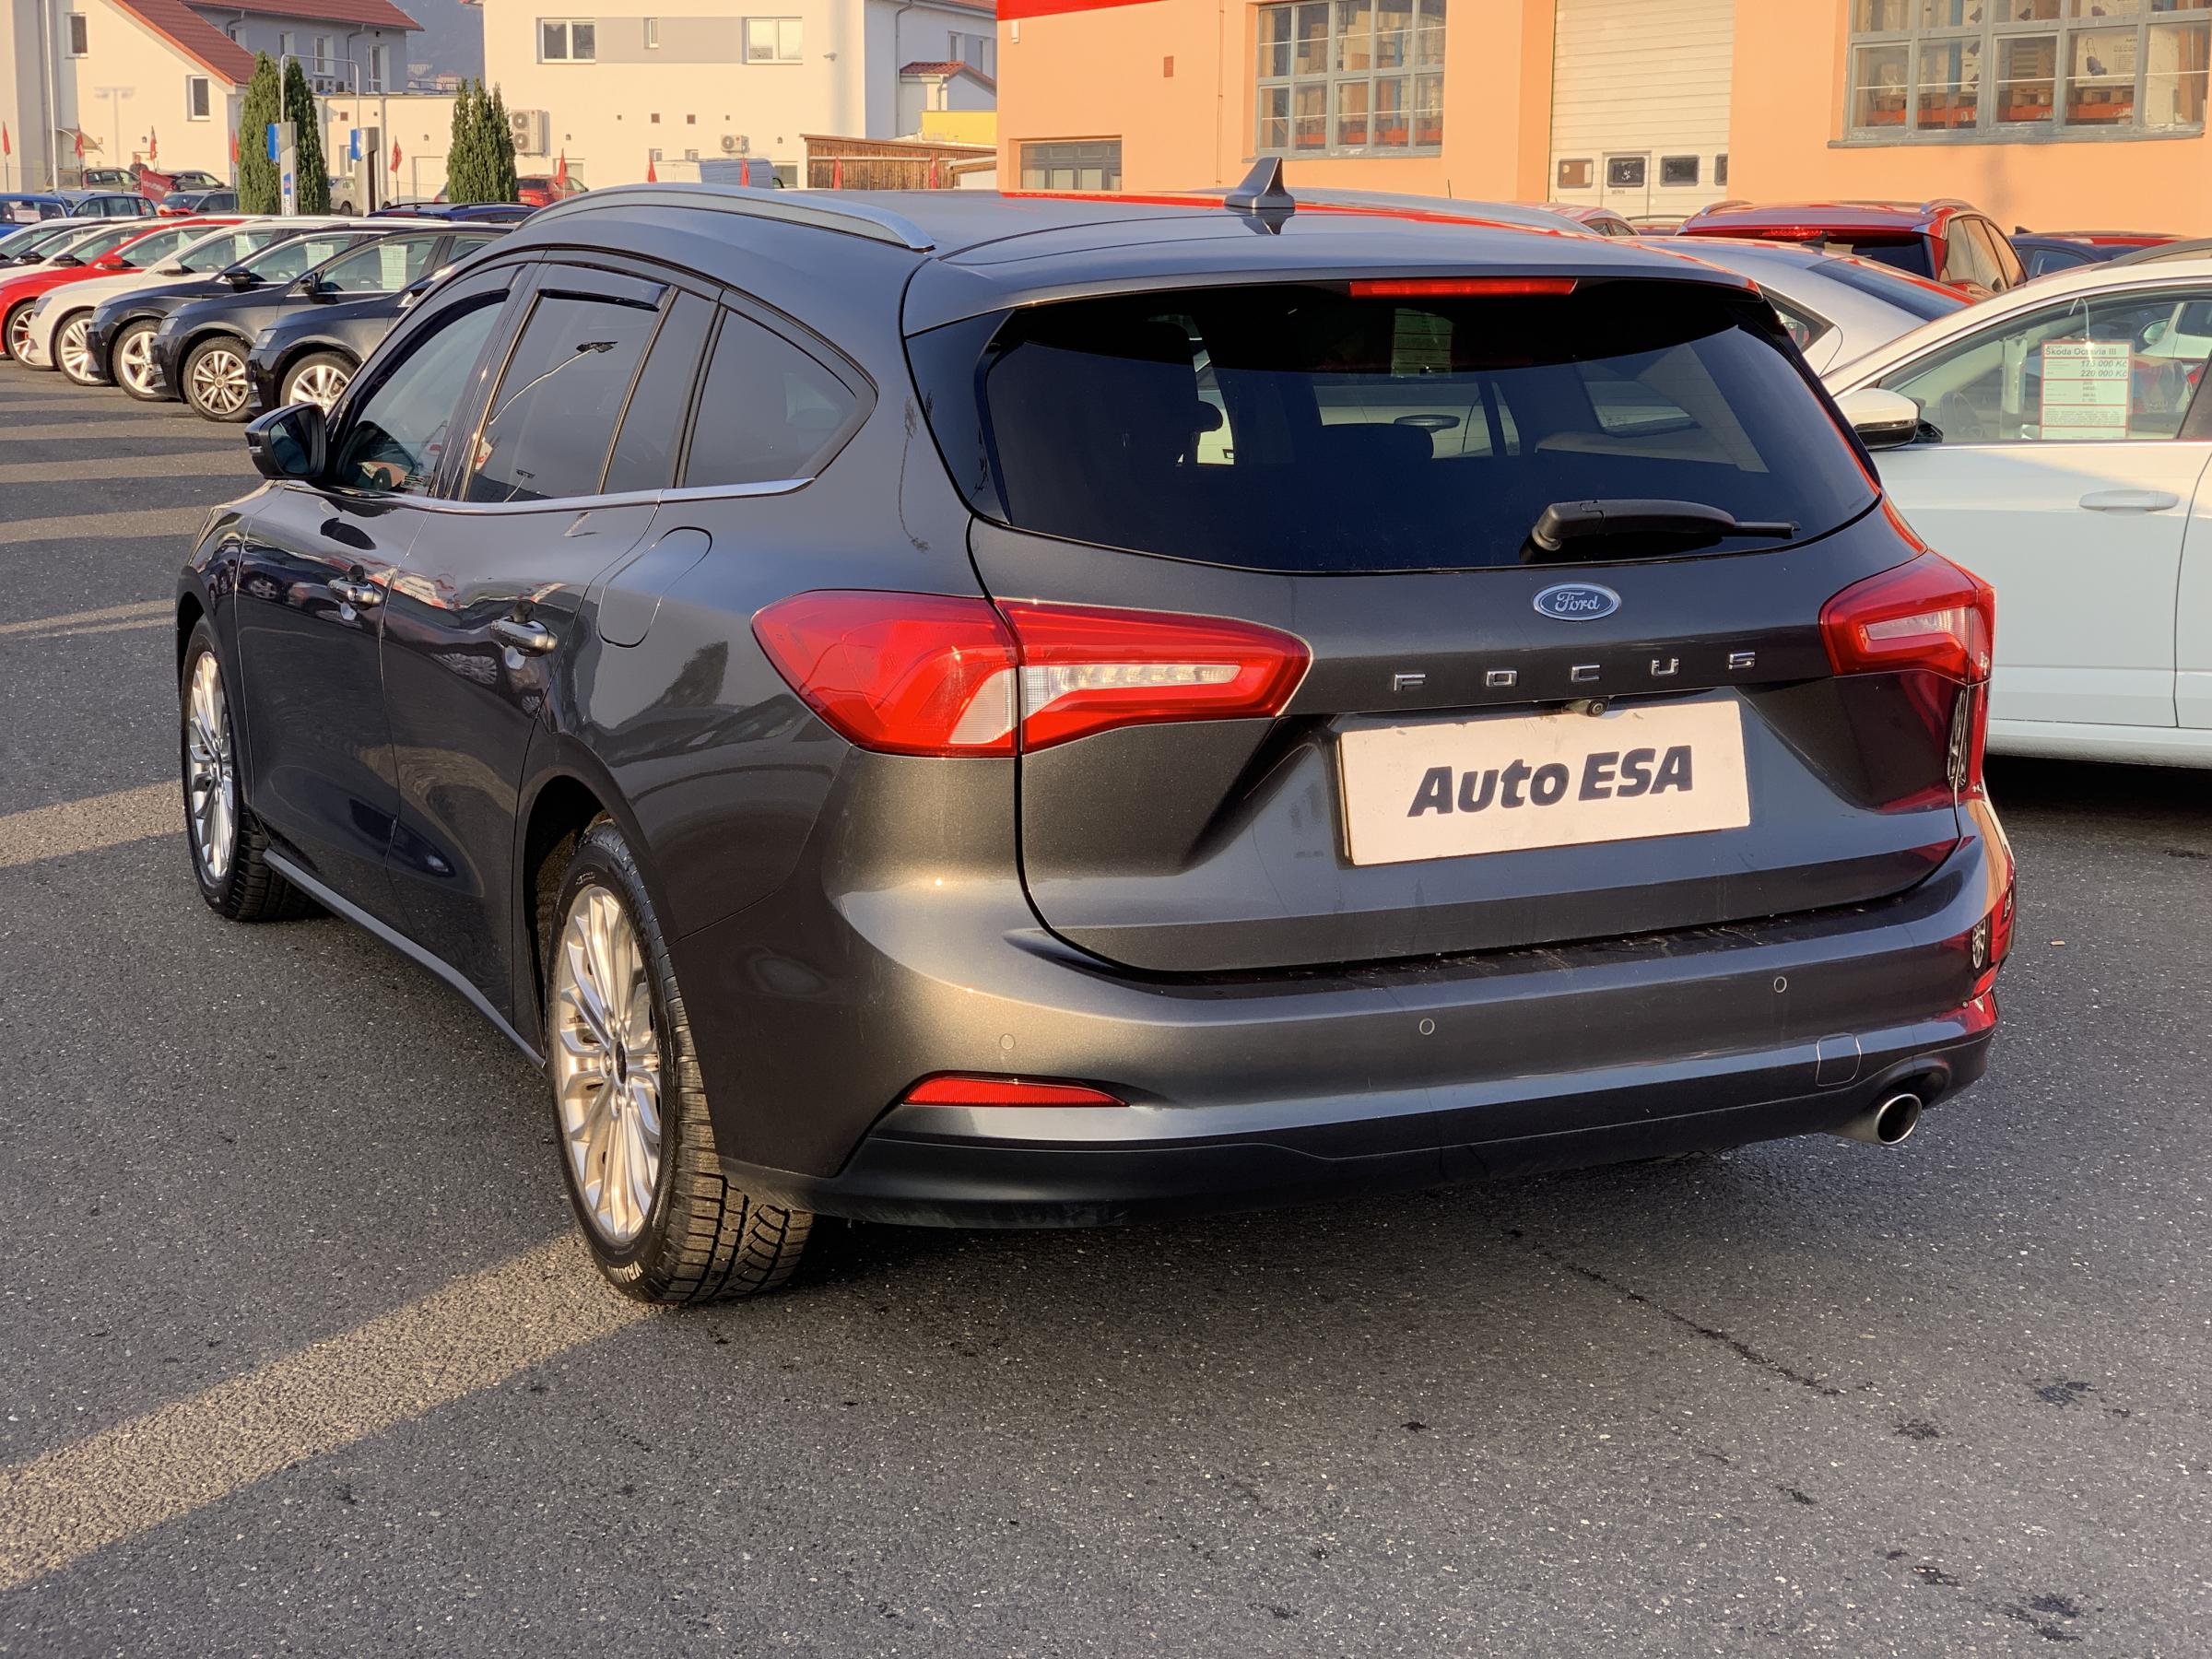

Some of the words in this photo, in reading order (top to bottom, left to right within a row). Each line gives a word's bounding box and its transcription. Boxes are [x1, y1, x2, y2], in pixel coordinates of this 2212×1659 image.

[1555, 592, 1600, 612] Ford
[1394, 651, 1756, 692] FOCUS
[1406, 759, 1569, 818] Auto
[1578, 745, 1693, 801] ESA
